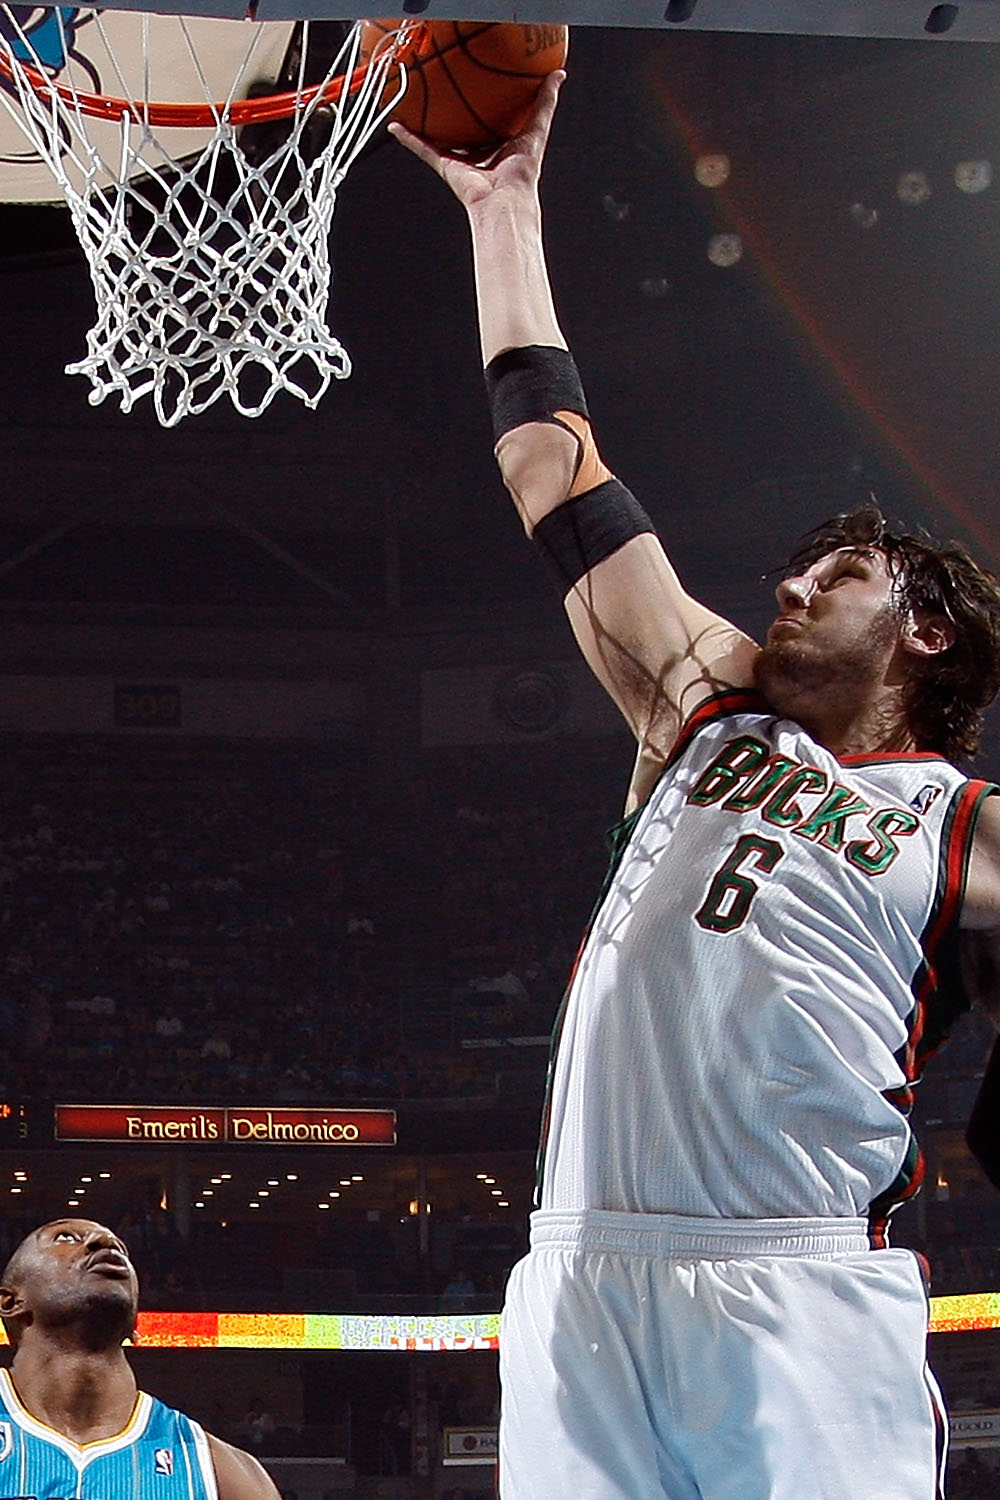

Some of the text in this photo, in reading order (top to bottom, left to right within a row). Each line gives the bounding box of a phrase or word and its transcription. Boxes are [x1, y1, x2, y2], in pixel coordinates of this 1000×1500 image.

[694, 833, 784, 932] 6
[126, 1112, 359, 1141] Emeril's Delmonico
